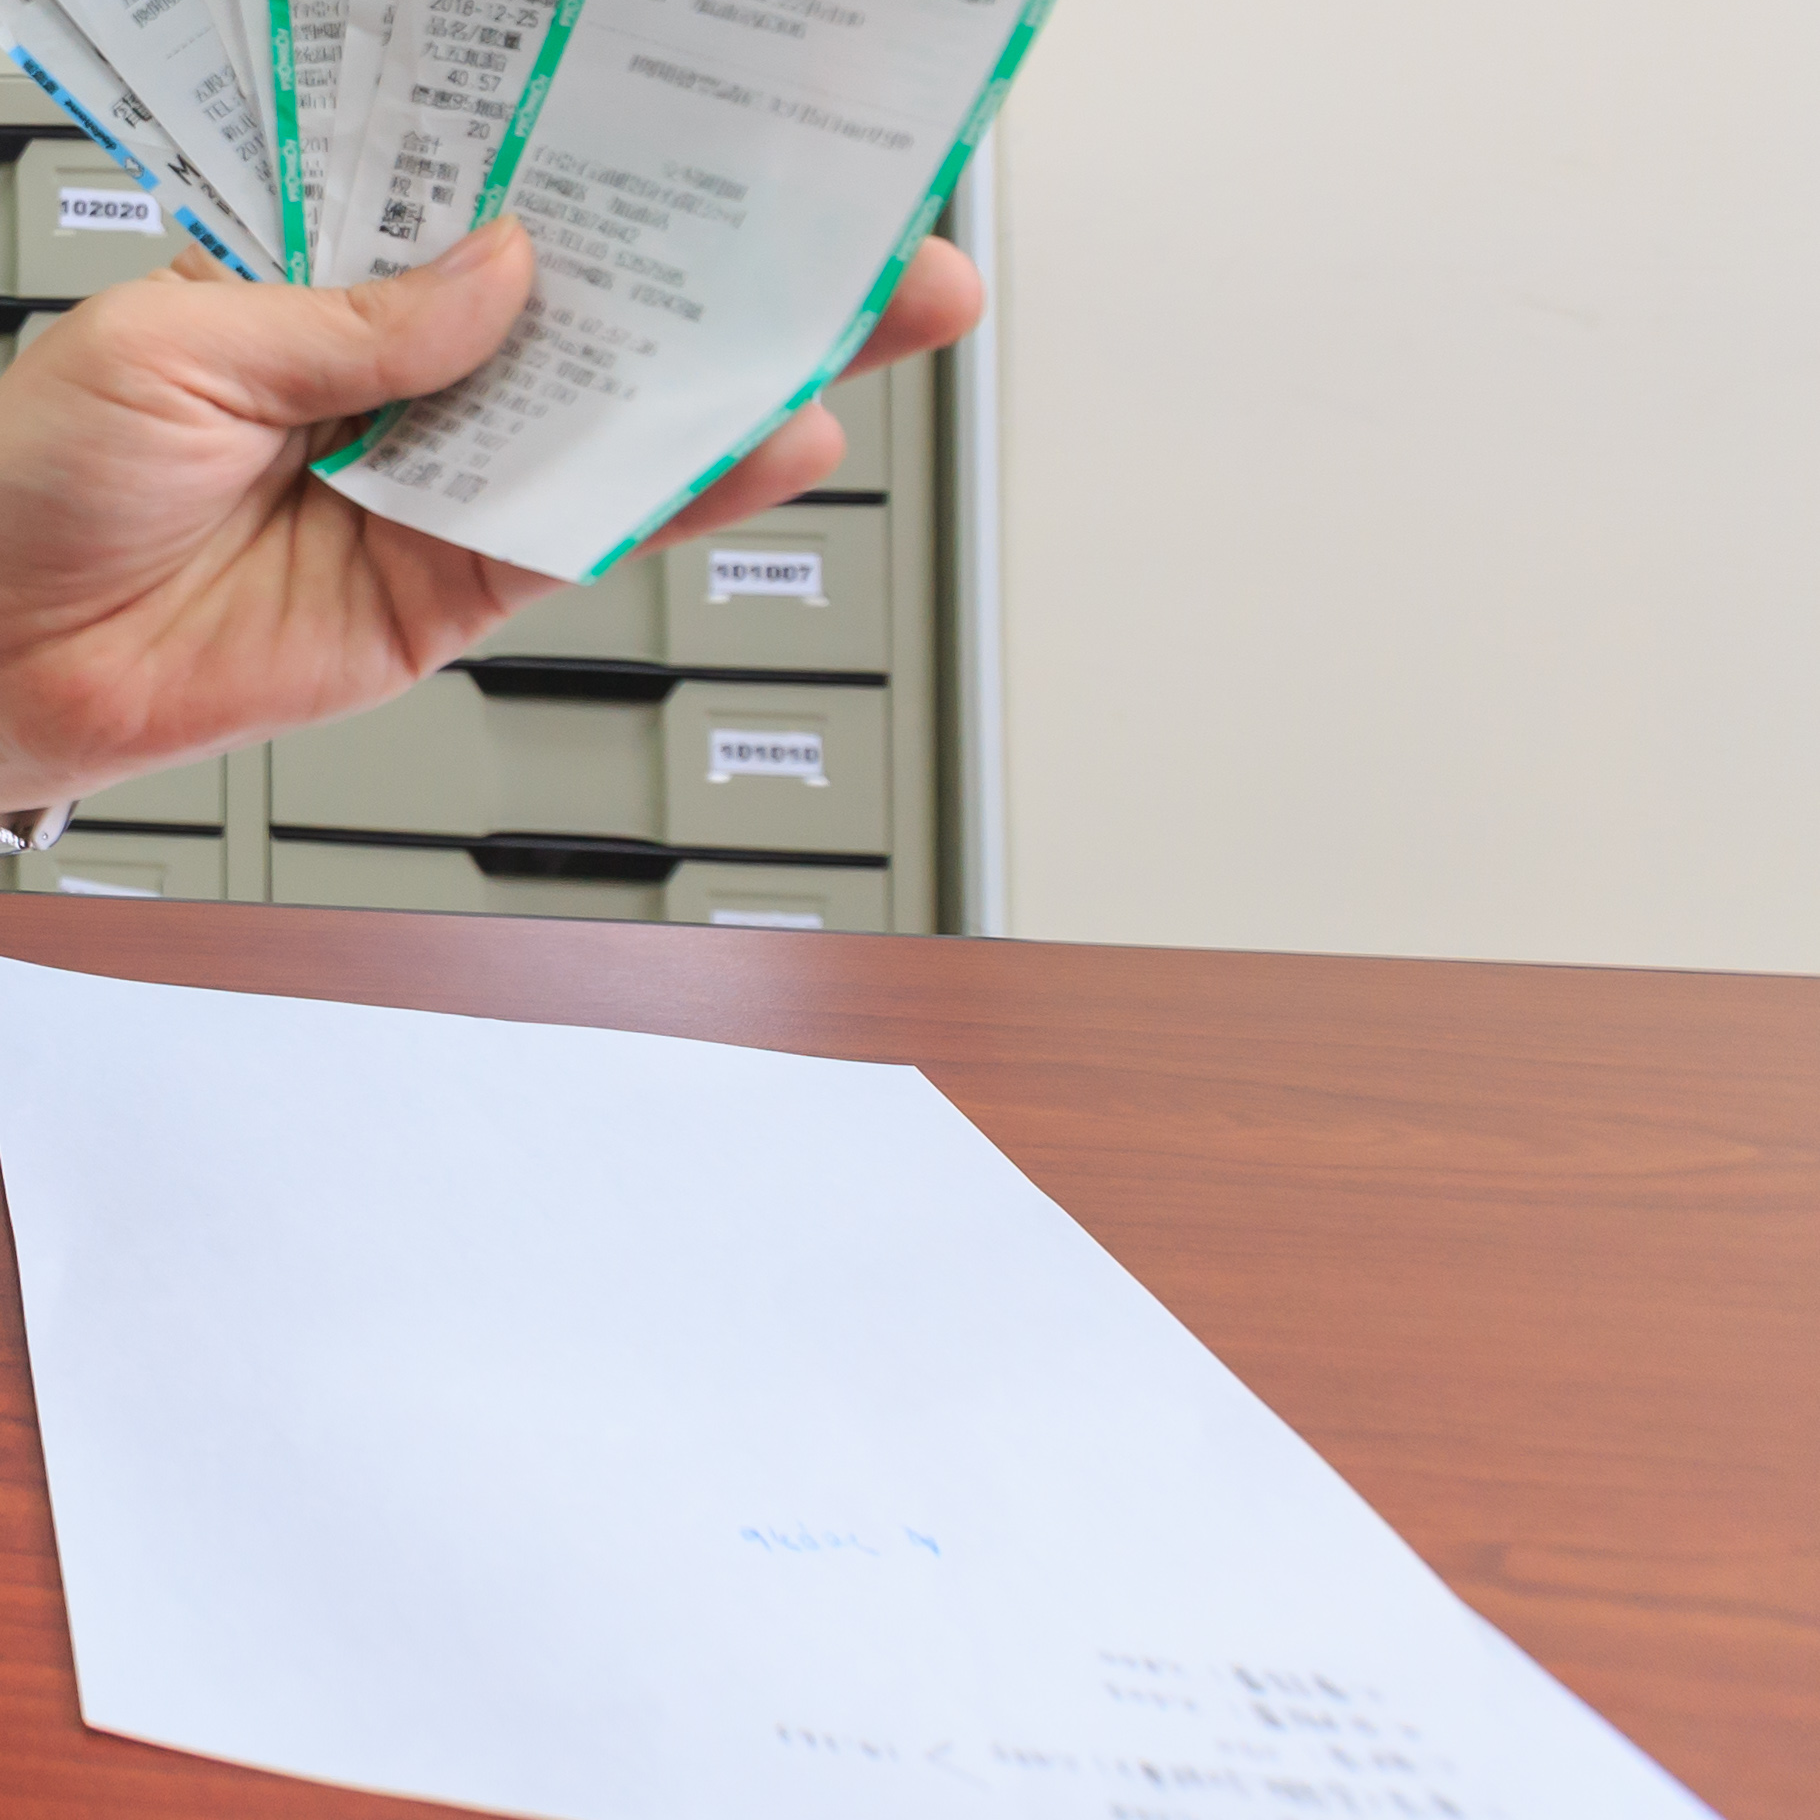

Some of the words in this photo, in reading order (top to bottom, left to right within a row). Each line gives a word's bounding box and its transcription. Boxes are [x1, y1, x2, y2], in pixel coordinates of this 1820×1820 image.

[60, 199, 149, 220] 102020
[716, 563, 814, 583] 101007
[721, 743, 819, 763] 101010
